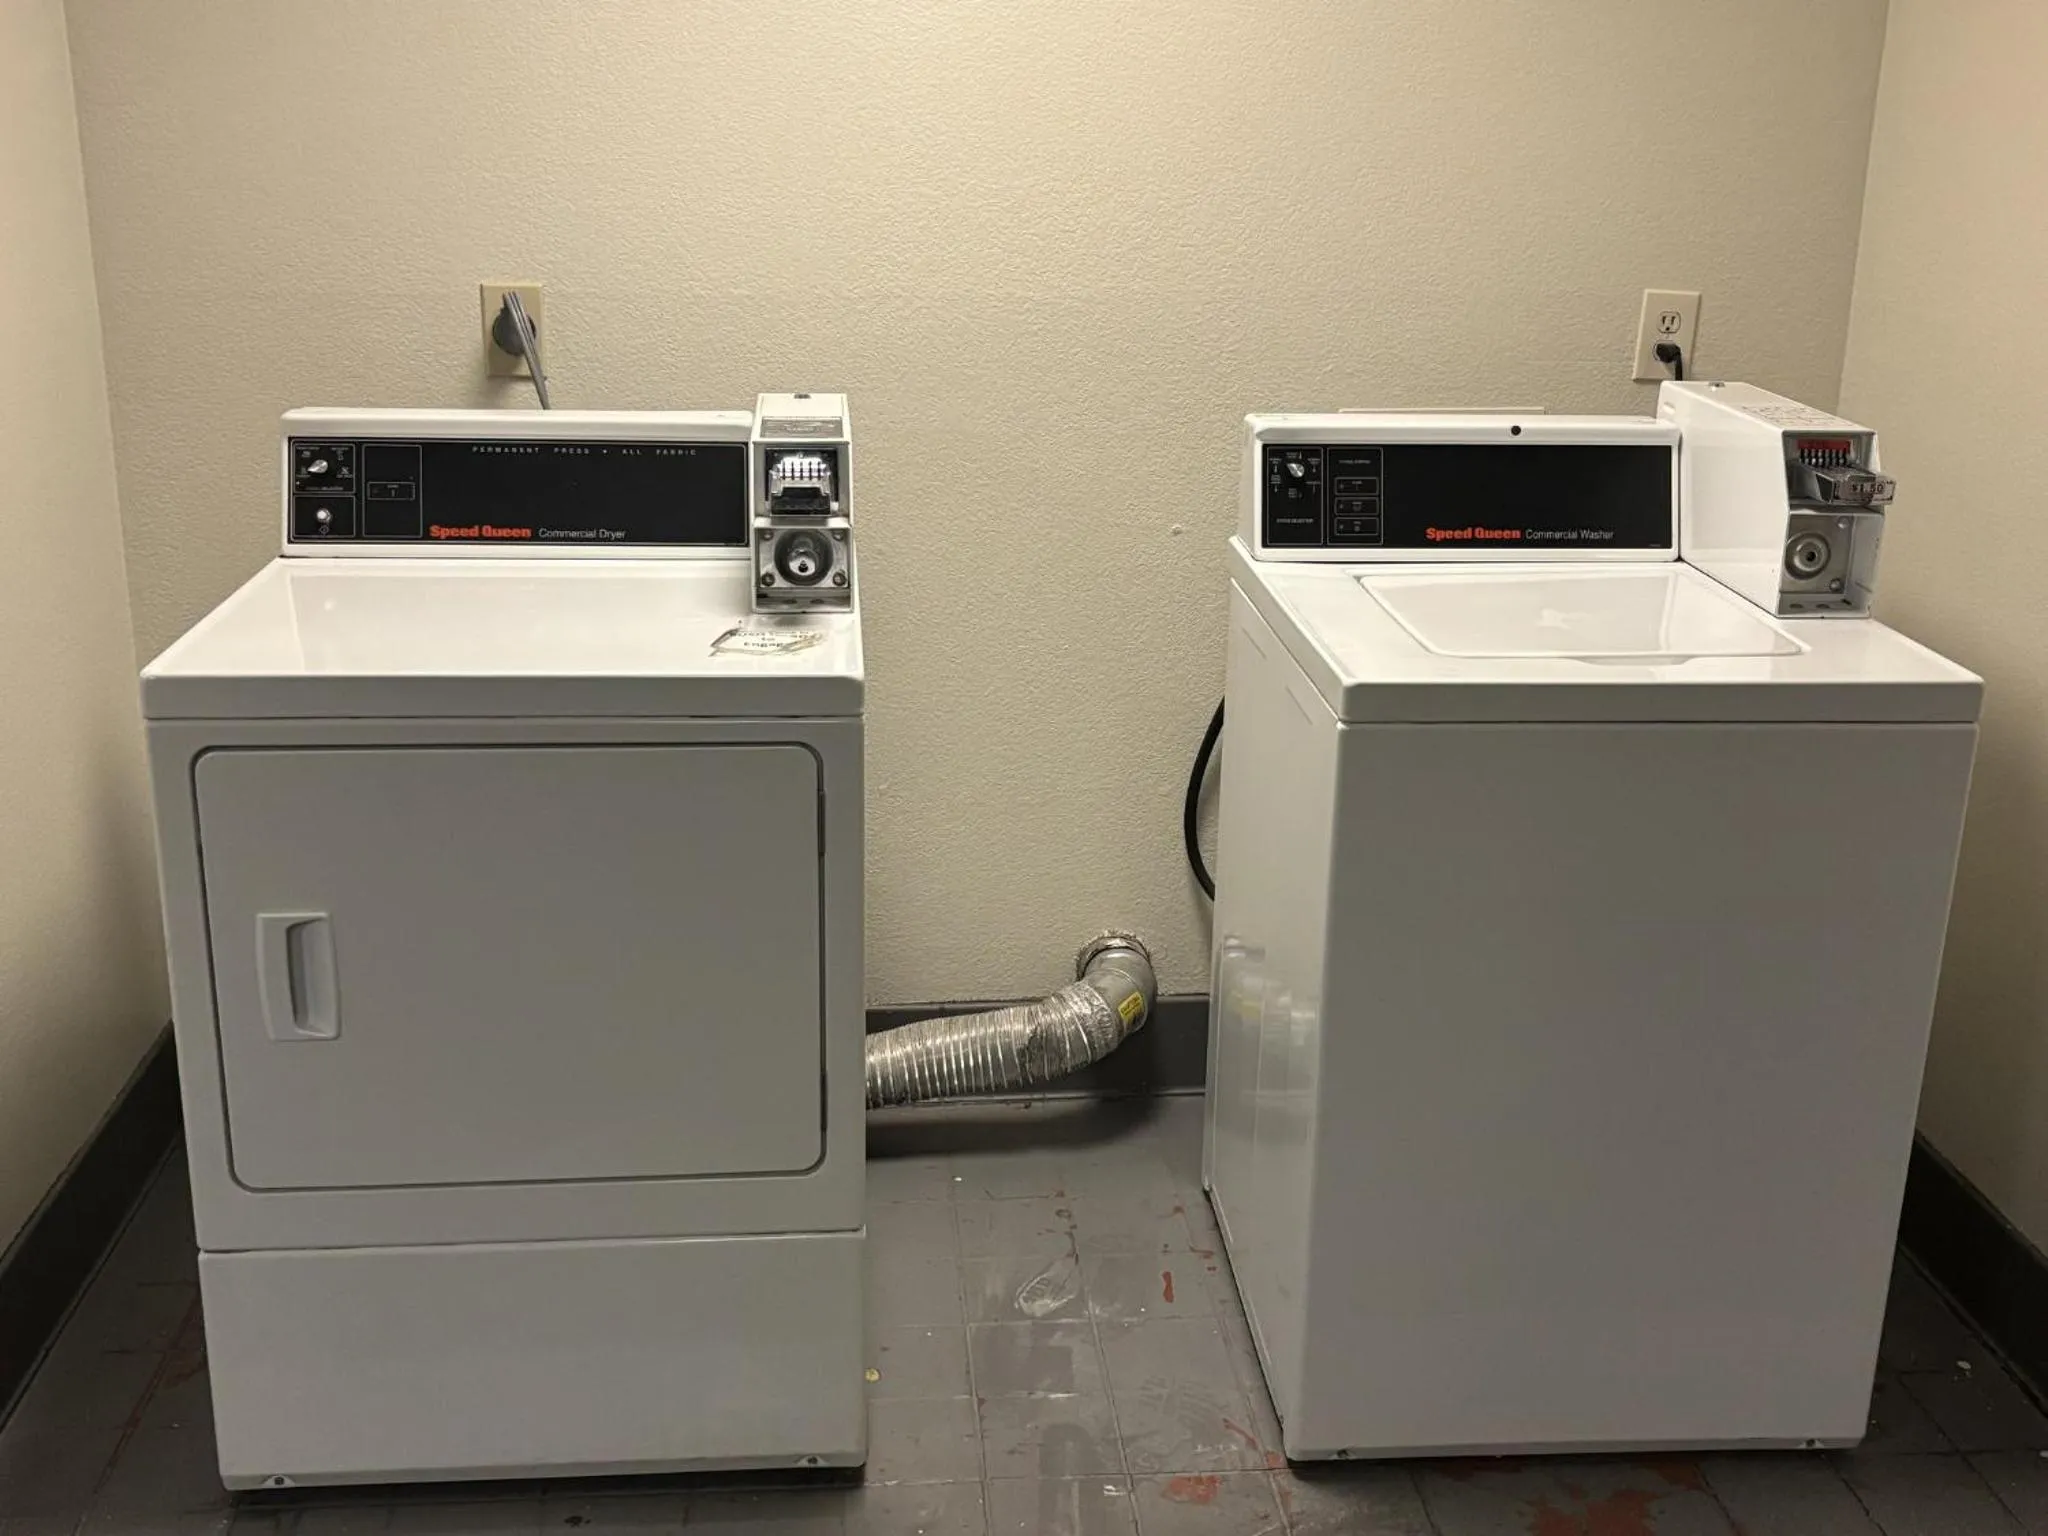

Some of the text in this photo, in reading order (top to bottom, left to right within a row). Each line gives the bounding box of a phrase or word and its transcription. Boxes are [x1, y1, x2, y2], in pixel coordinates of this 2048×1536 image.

[471, 446, 540, 454] PERMANENT
[553, 447, 590, 455] PRESS
[429, 525, 626, 541] Speed Queen Commercial Dryer
[1425, 527, 1615, 541] Speed Queen Commercial Washer
